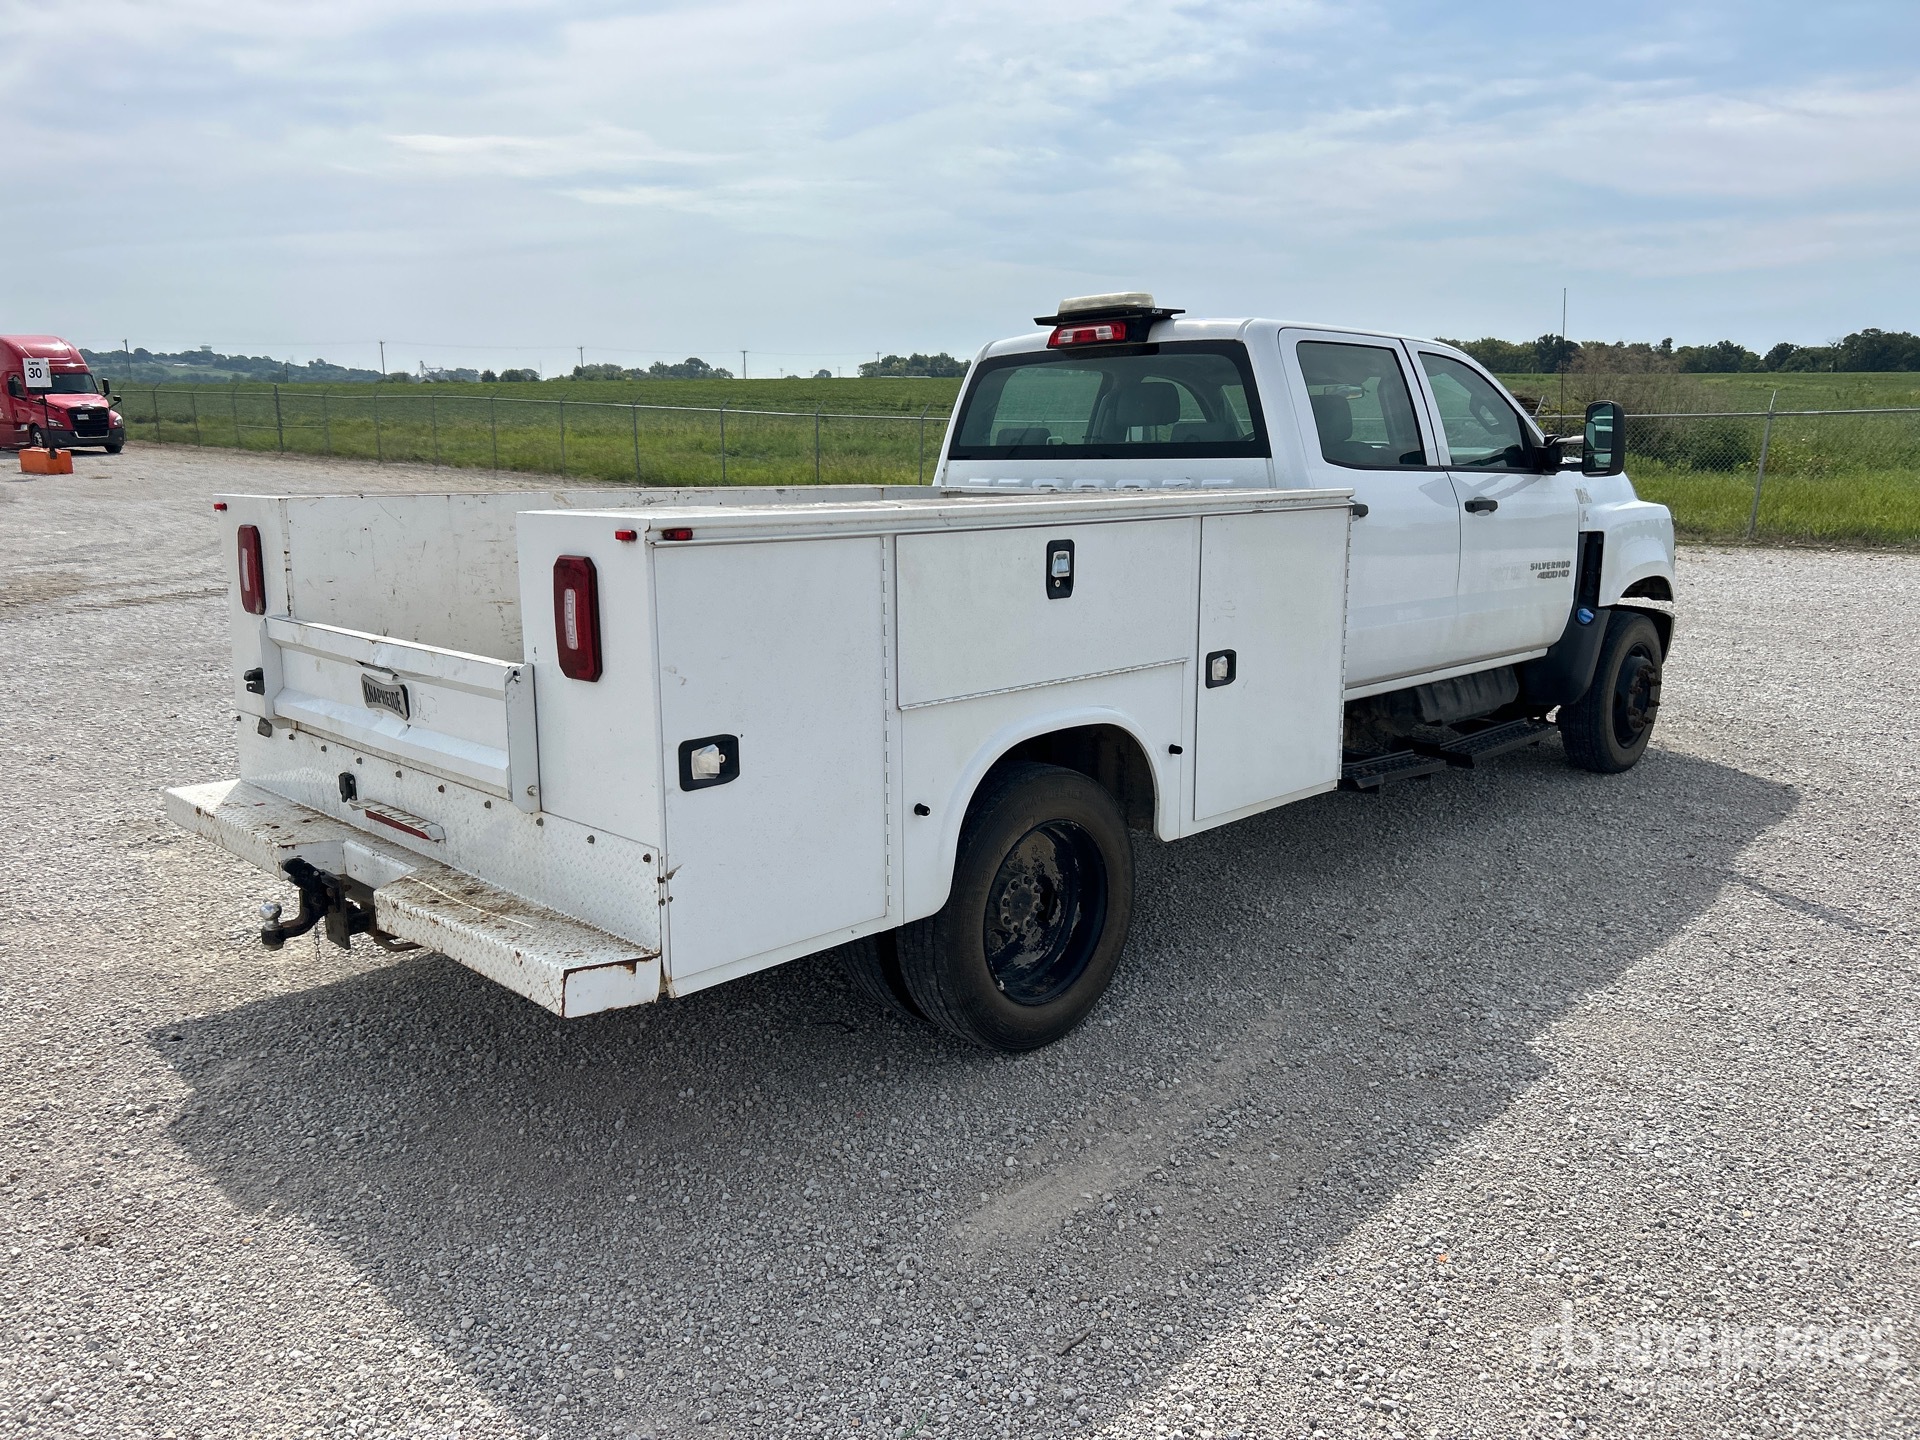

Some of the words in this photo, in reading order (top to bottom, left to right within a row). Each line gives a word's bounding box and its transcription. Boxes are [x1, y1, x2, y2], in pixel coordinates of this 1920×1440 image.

[28, 367, 42, 379] 30
[1530, 560, 1571, 571] SILVERADO
[362, 680, 404, 715] KNAPHEIDE
